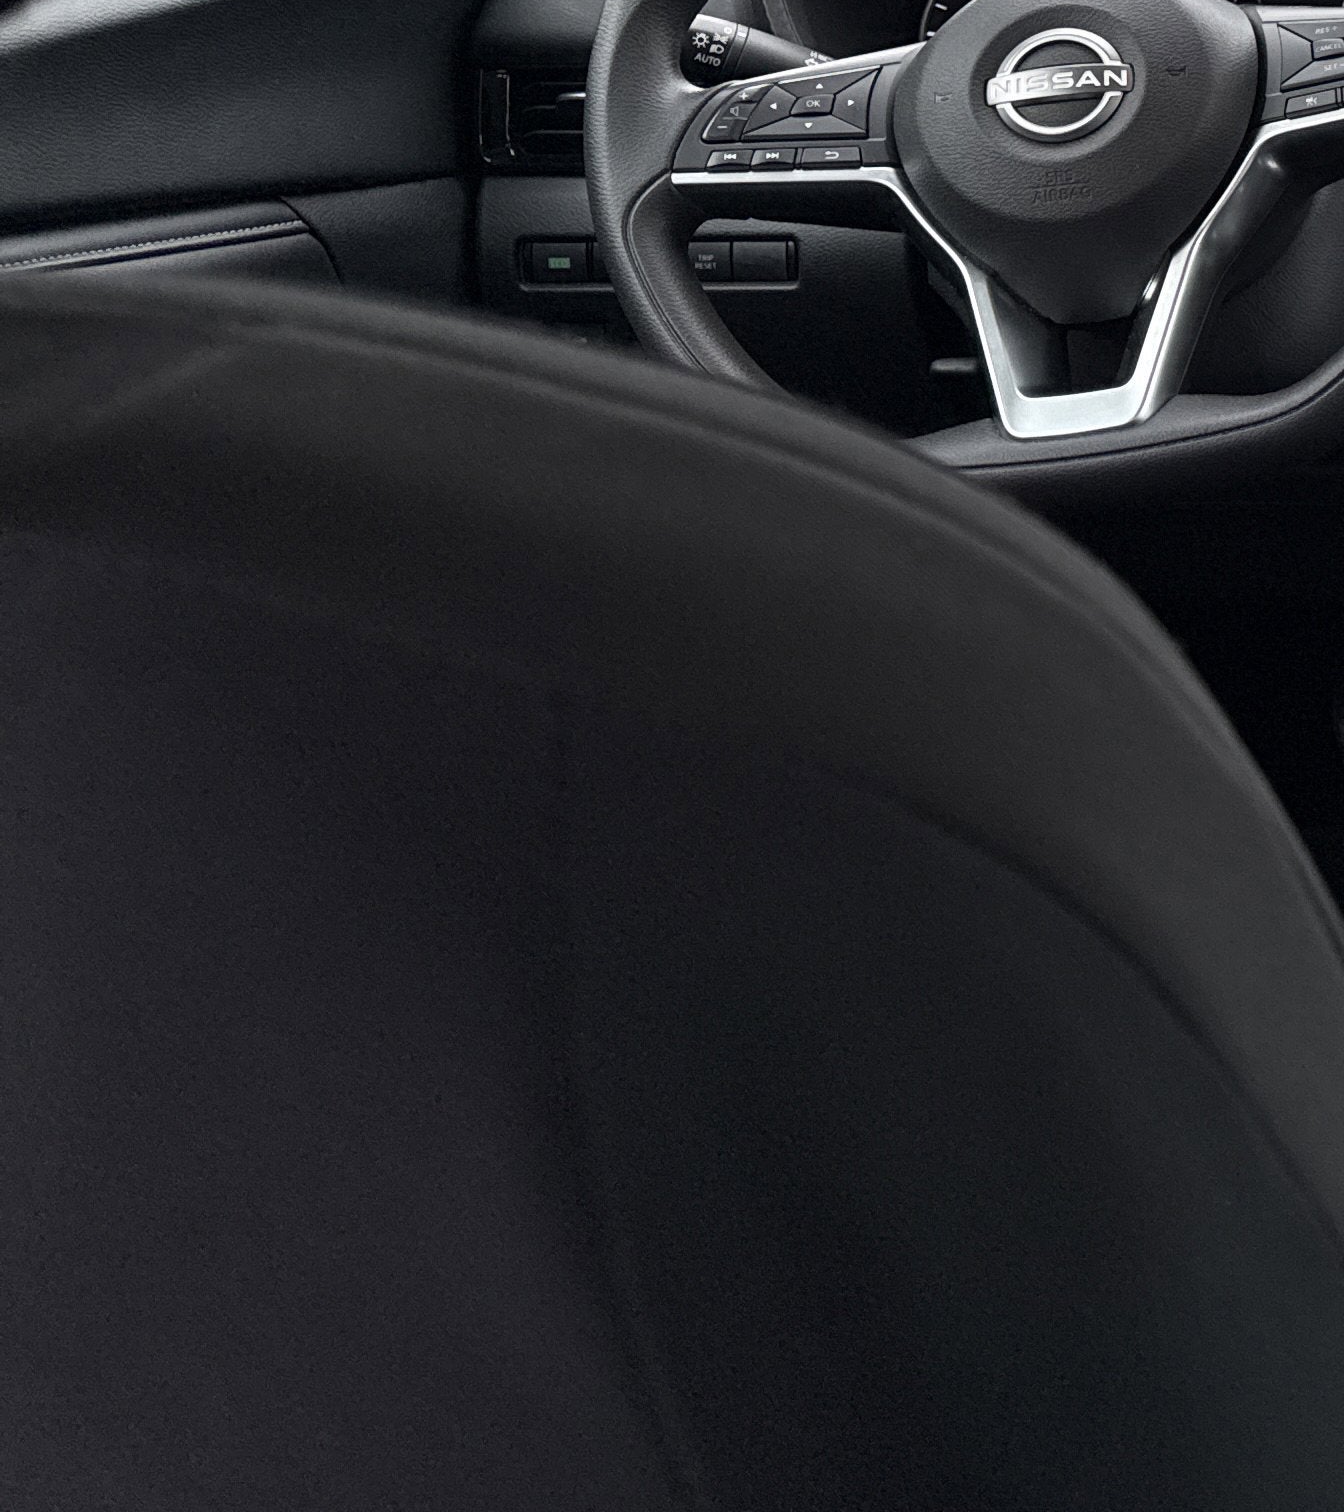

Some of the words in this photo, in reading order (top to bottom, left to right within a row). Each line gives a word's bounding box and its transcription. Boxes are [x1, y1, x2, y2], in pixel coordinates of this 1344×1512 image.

[693, 52, 721, 67] AUTO
[991, 69, 1128, 99] NISSAN
[806, 99, 821, 108] OK
[695, 261, 717, 270] RESET
